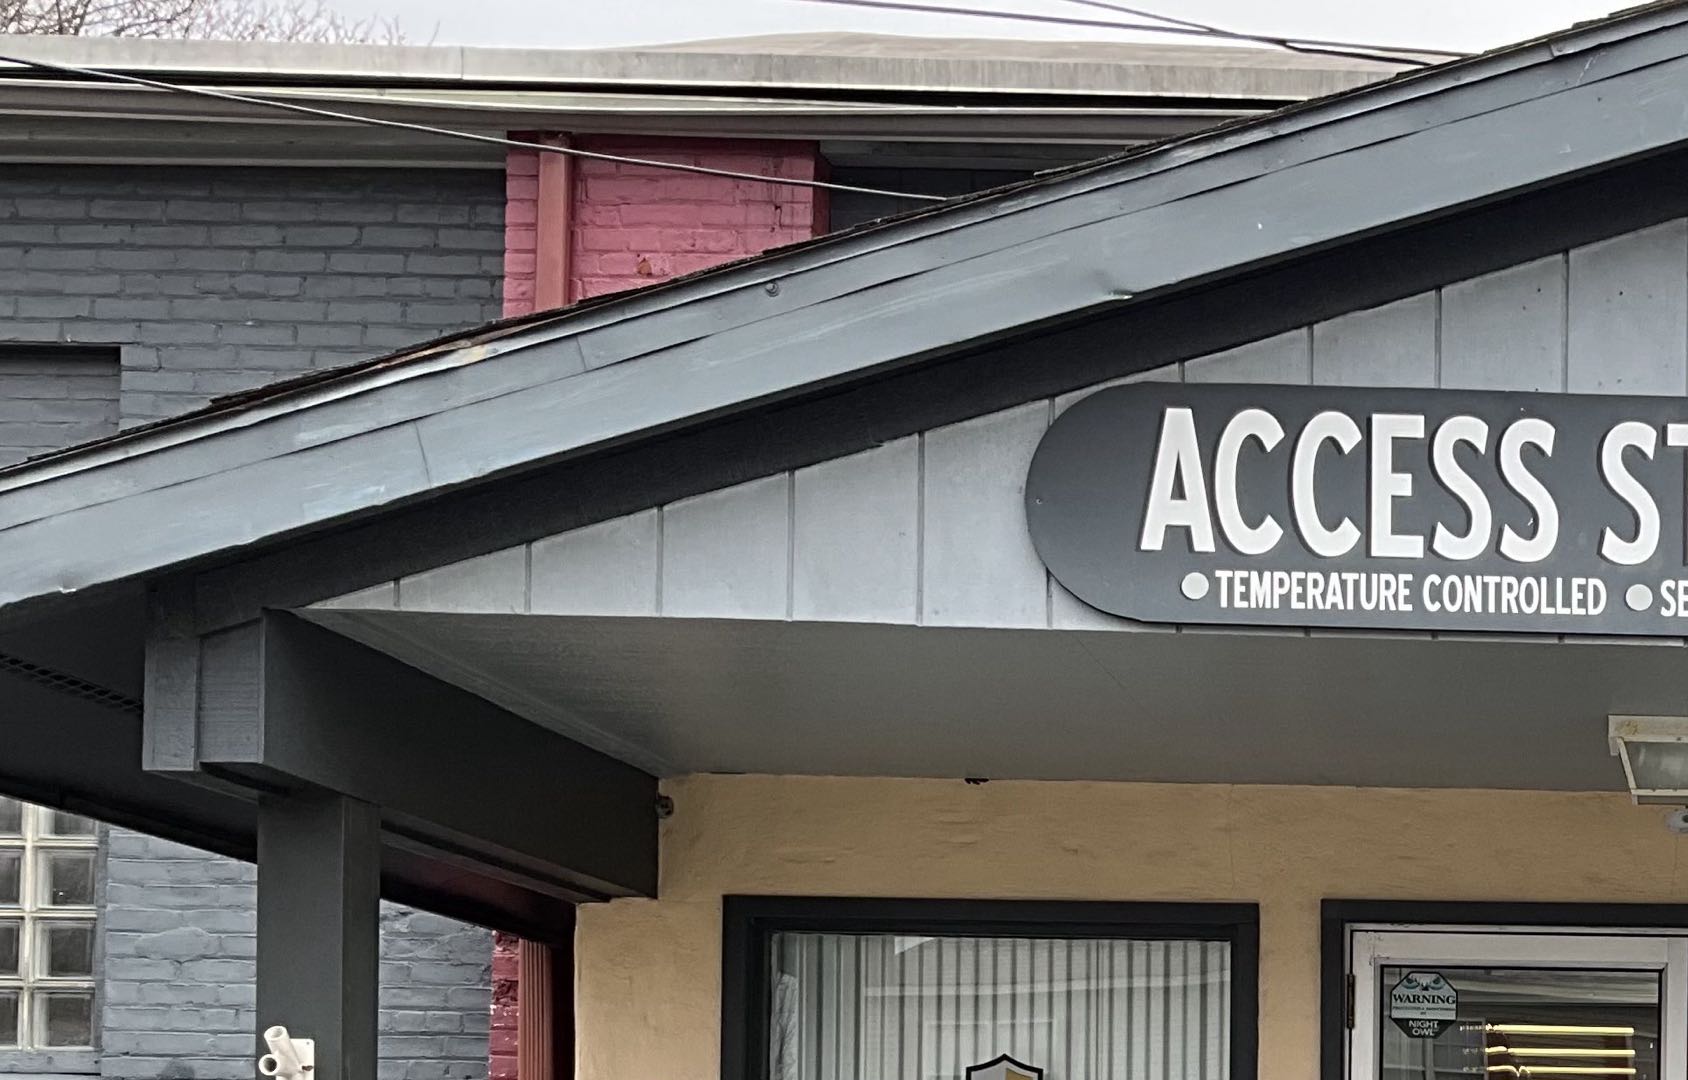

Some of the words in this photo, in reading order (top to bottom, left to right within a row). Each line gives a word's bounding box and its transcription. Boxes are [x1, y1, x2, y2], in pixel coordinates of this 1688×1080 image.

[1140, 407, 1559, 562] ACCESS
[1214, 570, 1413, 611] TEMPERATURE
[1423, 574, 1607, 616] CONTROLLED
[1392, 994, 1456, 1004] WARNING
[1408, 1020, 1439, 1028] NIGHT
[1412, 1028, 1435, 1036] OWL
